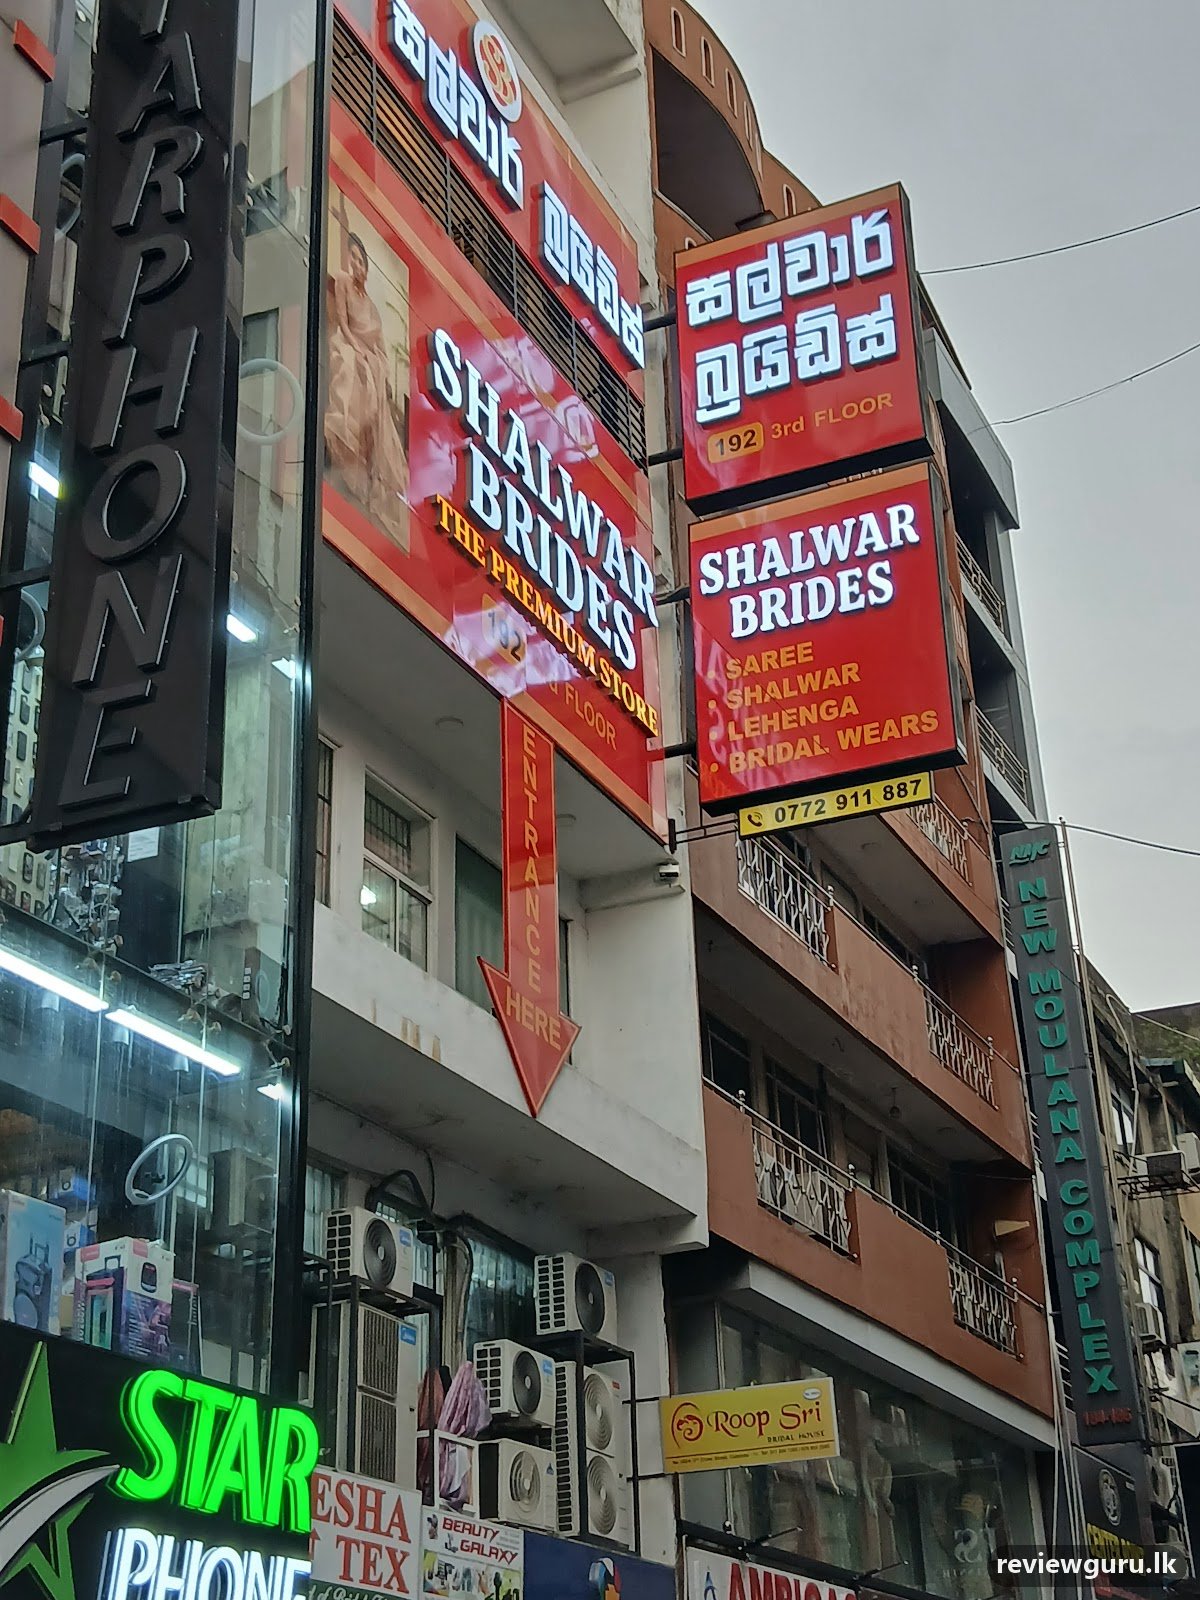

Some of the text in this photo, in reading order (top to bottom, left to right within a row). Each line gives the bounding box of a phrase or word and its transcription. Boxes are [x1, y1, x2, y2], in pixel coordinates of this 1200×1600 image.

[715, 392, 894, 456] 192 3rd FLOOR
[430, 327, 659, 628] SHALWAR
[468, 441, 637, 671] BRIDES
[699, 503, 920, 596] SHALWAR
[436, 493, 659, 738] THE PREMIUM STORE
[730, 559, 895, 639] BRIDES
[726, 641, 814, 680] SAREE
[727, 662, 861, 710] SHALWAR
[565, 682, 617, 751] FLOOR
[728, 696, 860, 742] LEHENGA
[729, 709, 939, 774] BRIDAL WEARS
[774, 779, 923, 824] 0772 911 887
[522, 722, 542, 995] ENTRANCE
[506, 986, 562, 1051] HERE
[1018, 876, 1120, 1394] NEW MOULANA COMPLEX
[114, 1369, 320, 1534] STAR
[706, 1401, 822, 1438] Roop Sri
[442, 1517, 500, 1543] BEAUTY
[460, 1539, 519, 1565] GALAXY
[335, 1535, 410, 1595] TEX
